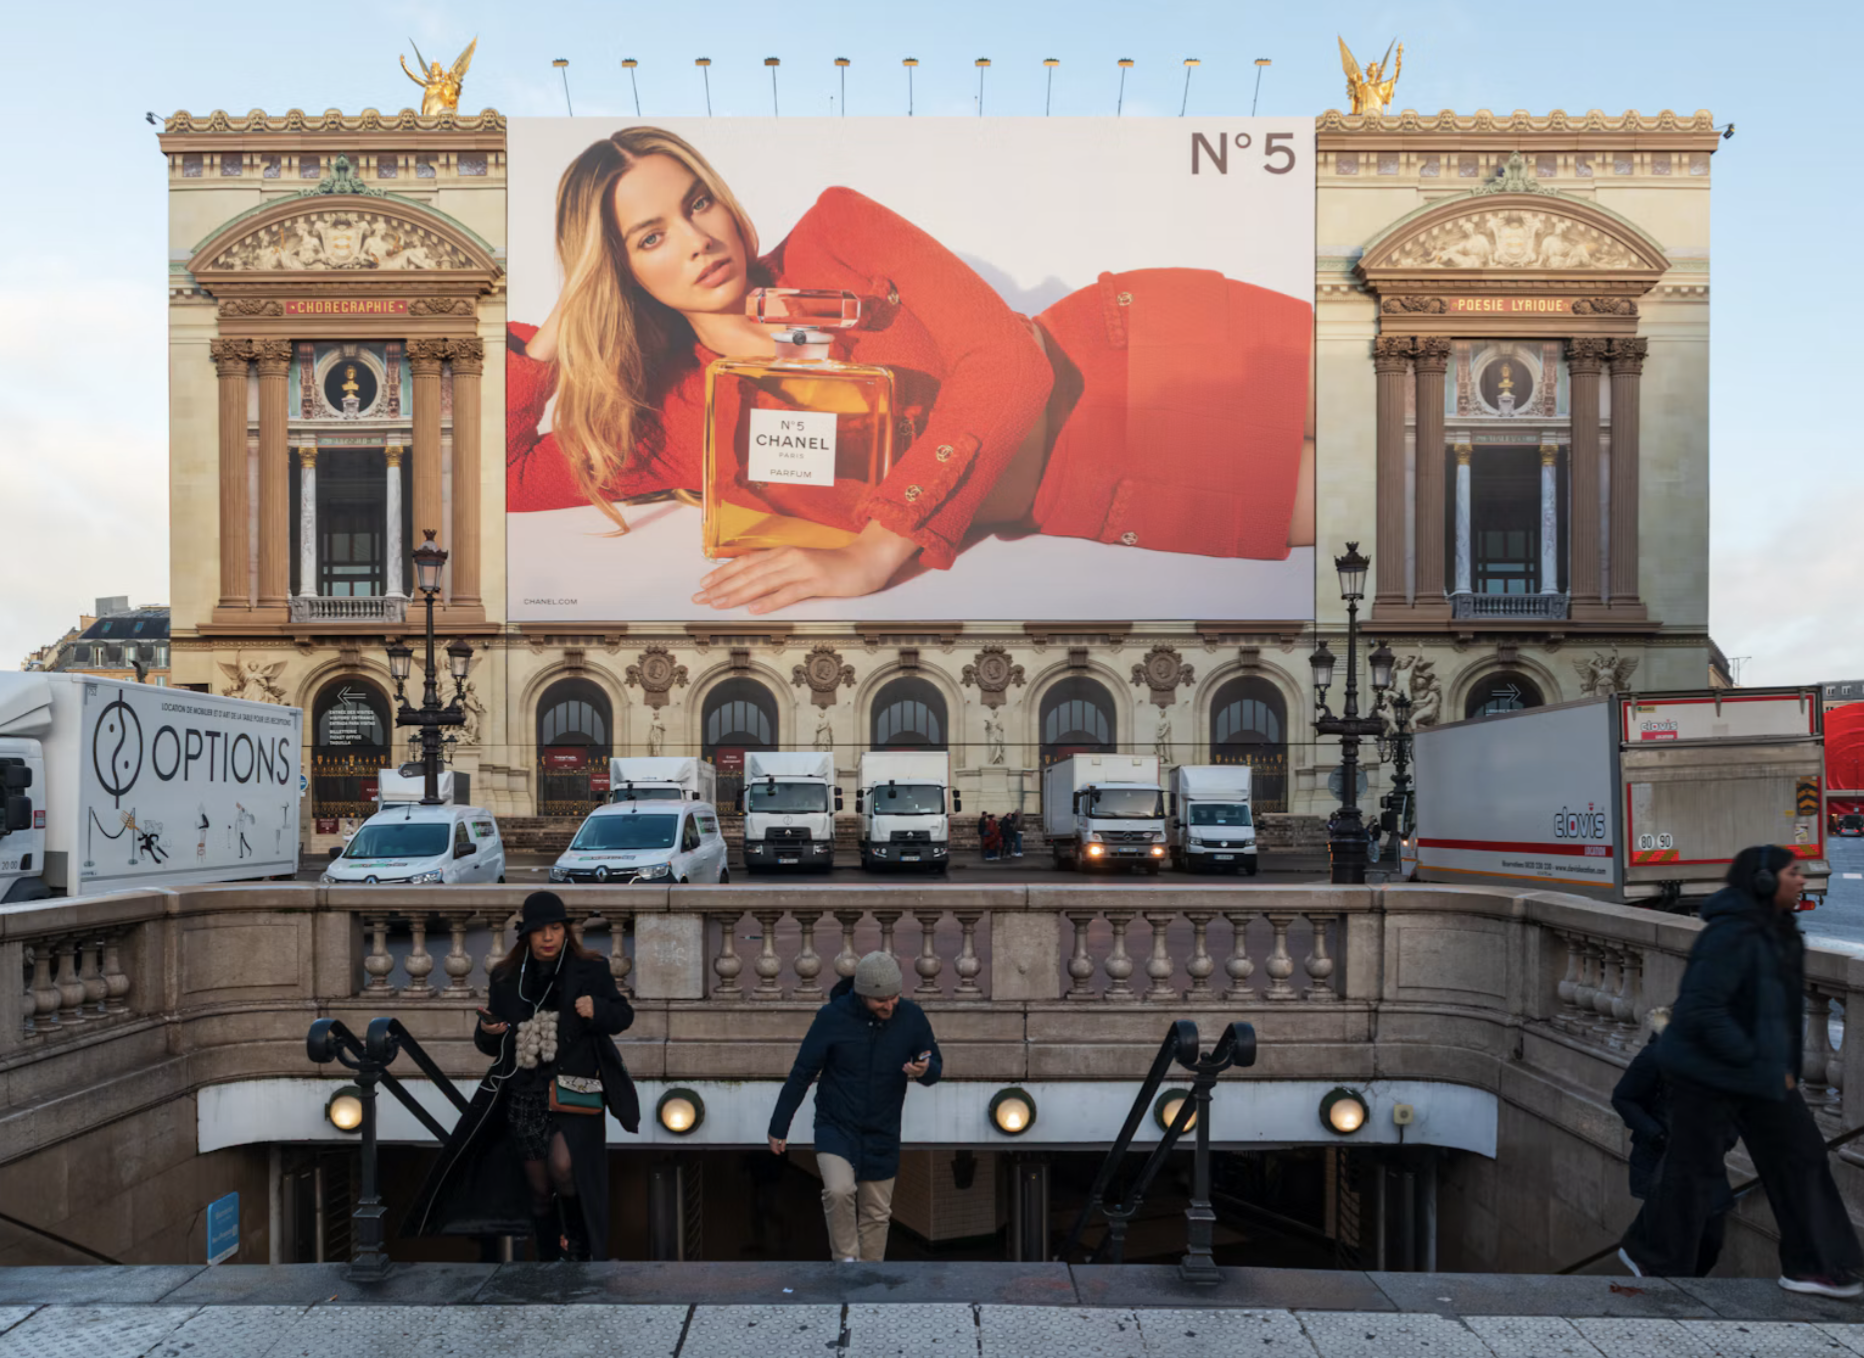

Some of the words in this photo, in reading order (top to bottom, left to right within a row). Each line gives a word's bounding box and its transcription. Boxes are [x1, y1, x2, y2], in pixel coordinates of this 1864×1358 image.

[298, 301, 395, 313] CHOREGRAPHIE
[1458, 299, 1504, 311] POESIE
[1511, 299, 1563, 312] LYRIQUE
[756, 434, 829, 450] CHANEL
[770, 469, 812, 478] PARFUM
[161, 702, 186, 713] LOCATION
[186, 706, 193, 714] DE
[1641, 719, 1678, 731] clovis
[152, 724, 290, 785] OPTIONS
[1554, 802, 1606, 839] clovis
[1641, 835, 1652, 848] 80
[1660, 835, 1670, 848] 90
